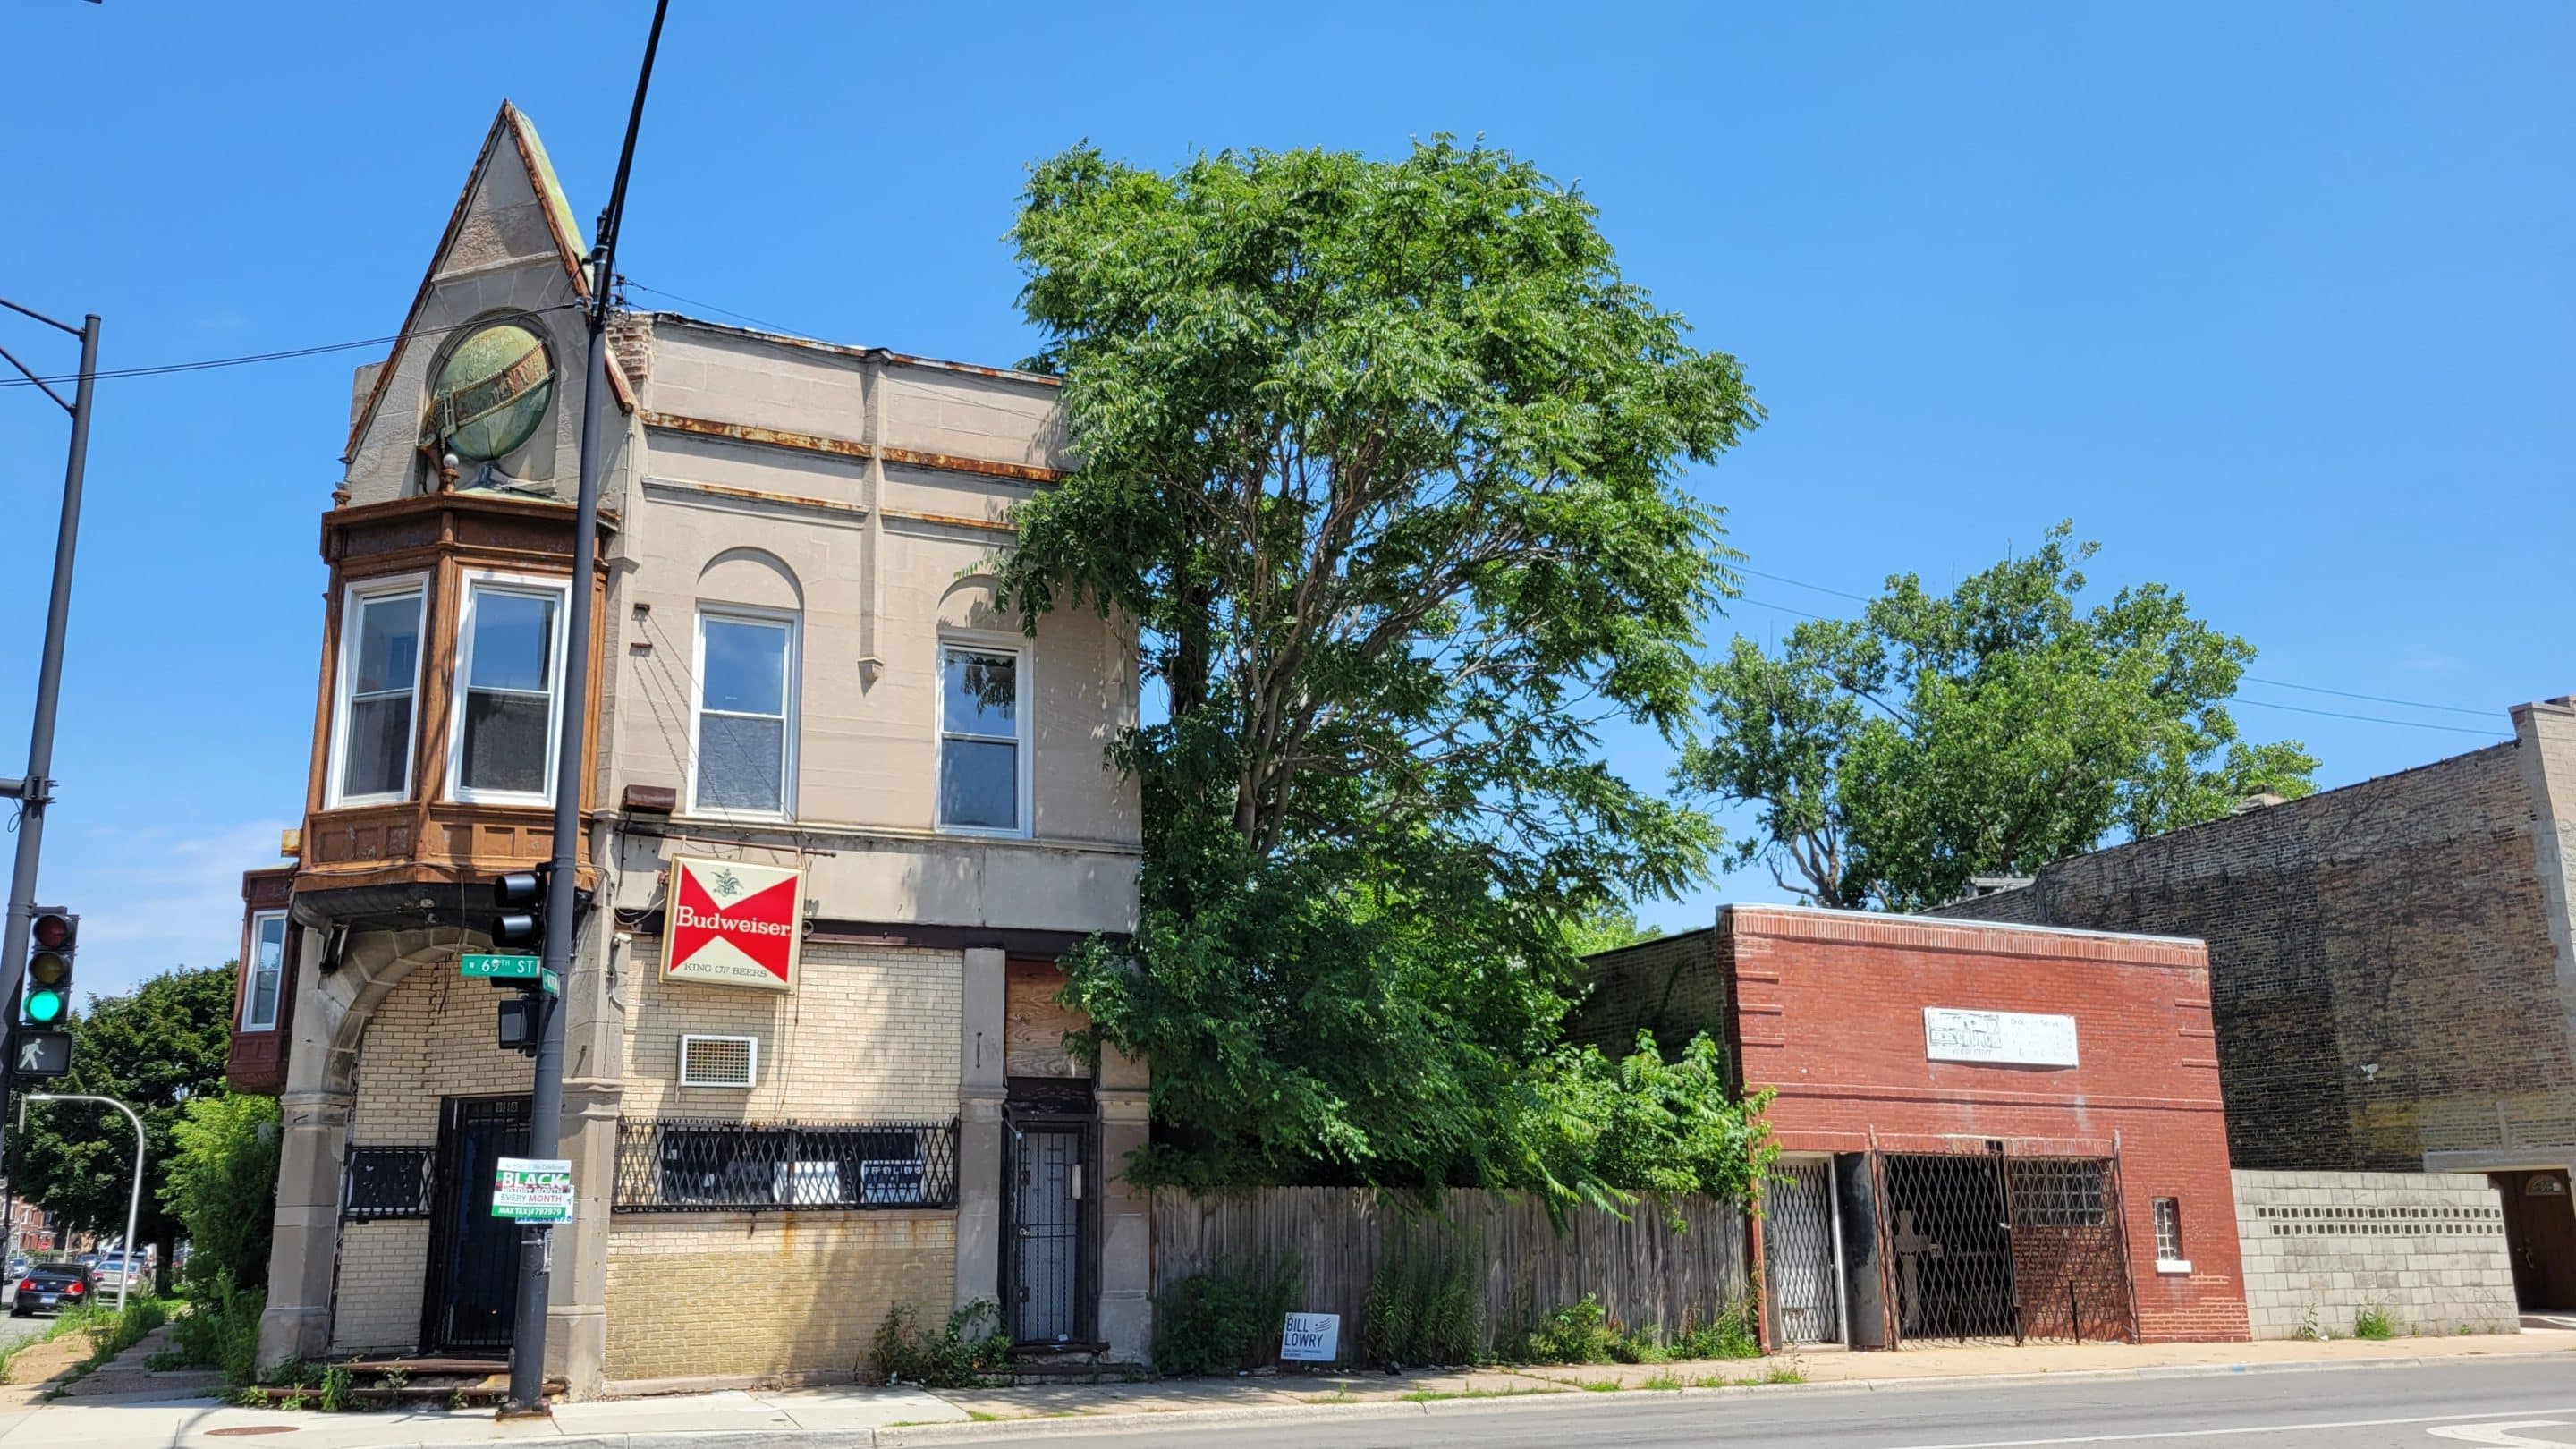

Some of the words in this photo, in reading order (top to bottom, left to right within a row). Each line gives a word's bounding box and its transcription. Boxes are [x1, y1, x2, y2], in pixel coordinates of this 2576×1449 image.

[676, 905, 791, 936] Budweiser
[517, 960, 534, 973] ST
[683, 962, 712, 973] KING
[715, 965, 730, 974] OF
[733, 967, 767, 978] BEERS
[502, 1172, 565, 1188] BLACK
[500, 1193, 527, 1202] EVERY
[528, 1194, 563, 1203] MONTH
[1286, 1318, 1309, 1333] BILL
[1284, 1332, 1324, 1348] LOWRY
